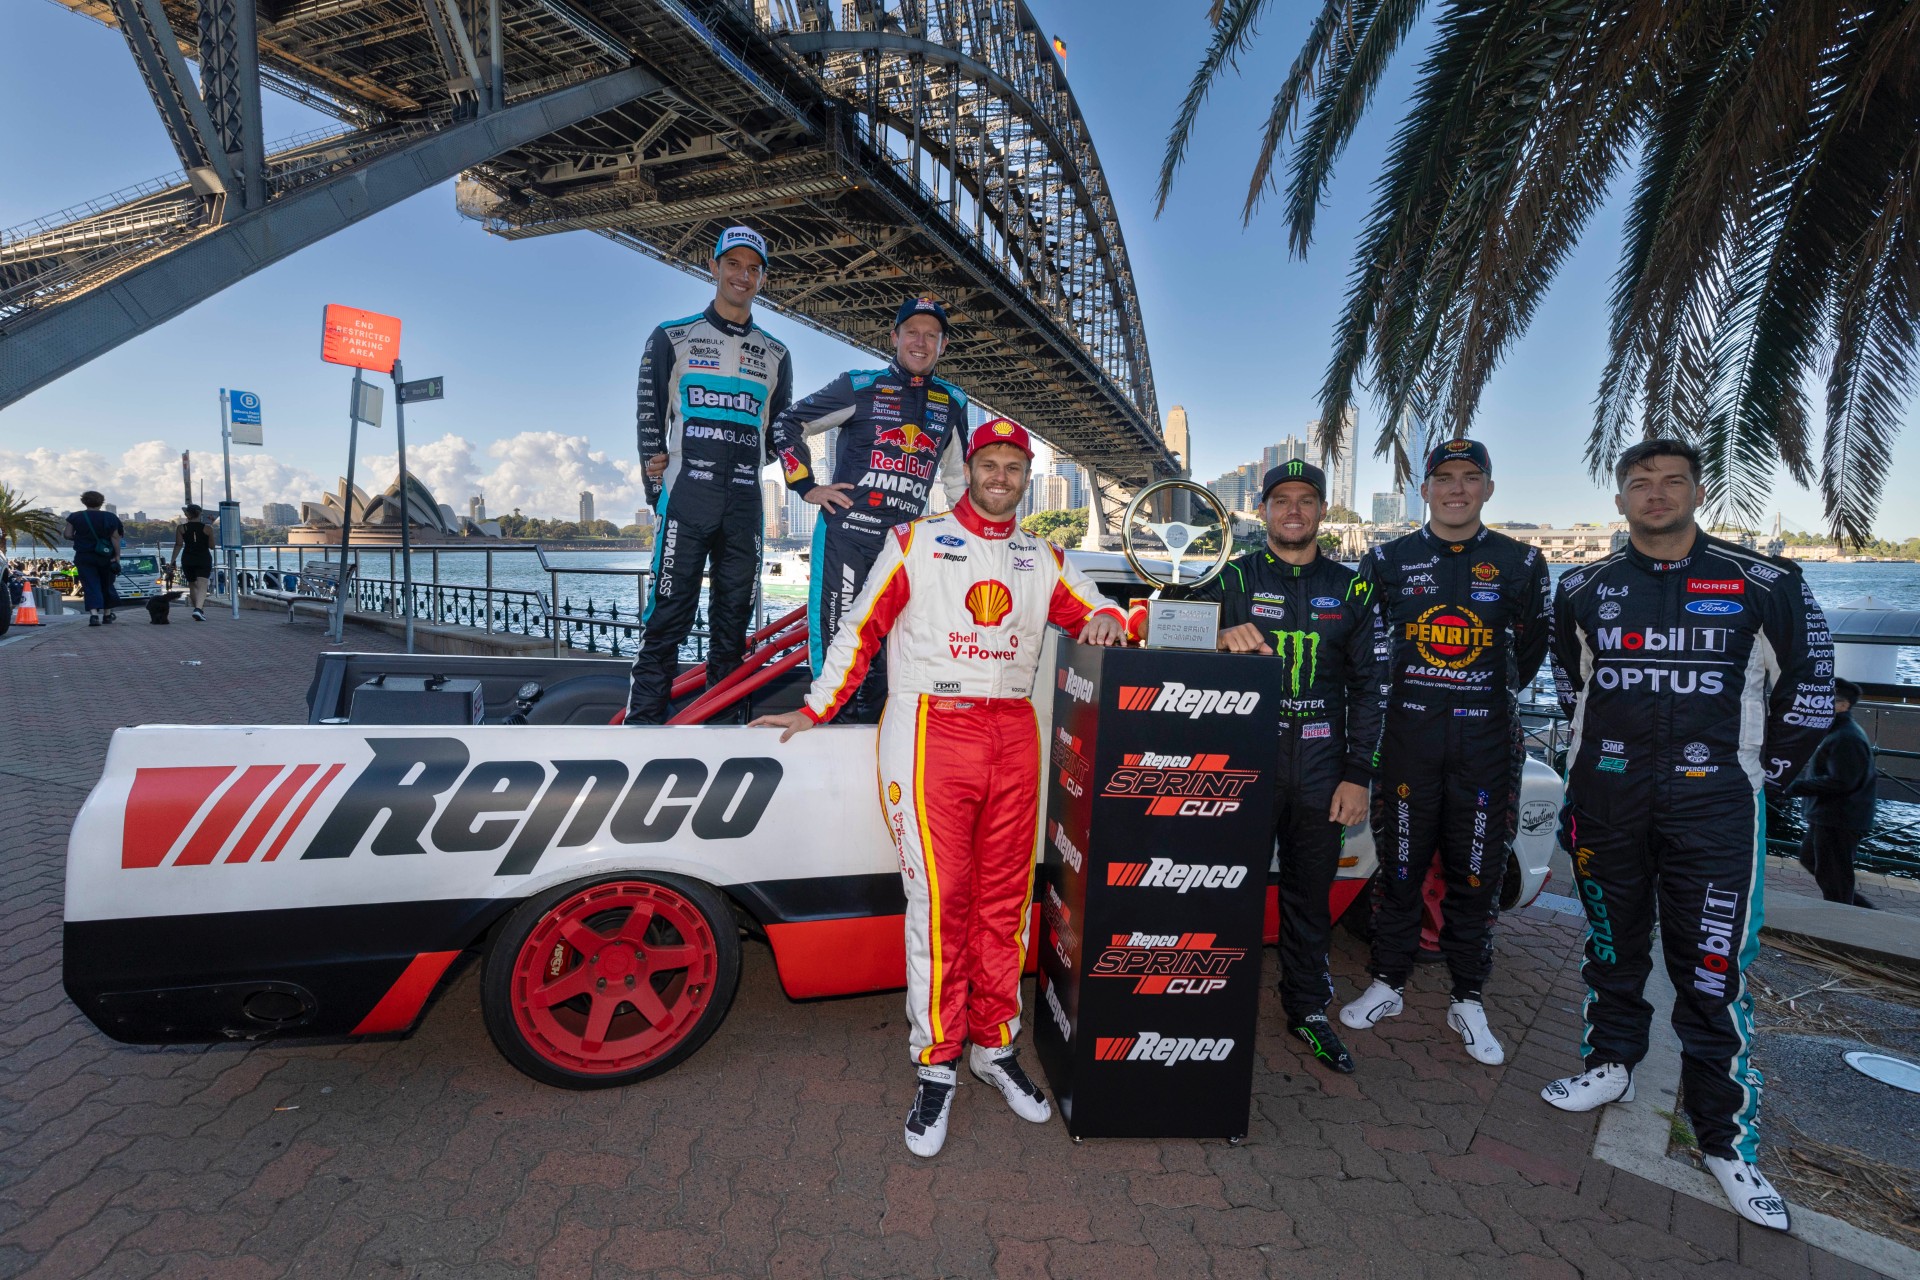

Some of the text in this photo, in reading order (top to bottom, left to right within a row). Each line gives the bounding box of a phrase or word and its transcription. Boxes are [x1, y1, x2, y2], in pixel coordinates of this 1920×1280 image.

[728, 232, 762, 246] Bendix
[355, 320, 374, 330] END
[336, 325, 391, 343] RESTRICTED
[669, 330, 685, 338] OMP
[342, 336, 383, 351] PARKING
[741, 342, 766, 355] AGI
[350, 347, 375, 359] AREA
[746, 357, 766, 368] TES
[245, 396, 254, 406] B
[687, 386, 761, 416] Bendix
[873, 406, 900, 416] Partners
[685, 425, 758, 447] SUPAGLASS
[870, 450, 934, 480] Red Bull
[857, 472, 928, 501] AMPOL
[846, 511, 881, 524] ACDelco
[940, 536, 960, 546] Ford
[660, 520, 679, 597] SUPAGLASS
[943, 552, 967, 563] Repco
[1402, 562, 1433, 571] Steadfast
[1472, 567, 1500, 576] PENRITE
[1653, 560, 1681, 571] Mobil
[1750, 565, 1778, 580] OMP
[1407, 572, 1435, 585] APEX
[1564, 573, 1584, 589] OMP
[1691, 582, 1740, 590] MORRIS
[1402, 586, 1437, 595] GROVE
[1597, 582, 1629, 600] yes
[1316, 598, 1334, 606] Ford
[1698, 602, 1729, 612] Ford
[829, 591, 838, 634] Premium
[949, 632, 977, 643] Shell
[1405, 622, 1493, 647] PENRITE
[1597, 627, 1685, 651] Mobil
[949, 645, 1017, 661] V-Power
[1405, 665, 1468, 679] RACING
[935, 682, 959, 690] rpm
[1065, 667, 1094, 704] Repco
[1404, 679, 1434, 687] AUSTRALIAN
[1597, 667, 1724, 695] OPTUS
[1797, 682, 1830, 692] Spicers
[1151, 681, 1260, 719] Repco
[1280, 699, 1325, 711] NSTER
[1793, 694, 1835, 709] NGK
[1468, 709, 1489, 717] MATT
[1806, 715, 1835, 723] TRUCK
[1800, 720, 1832, 729] ASSIST
[1303, 728, 1330, 738] RACEGEAR
[1602, 741, 1624, 752] OMP
[1051, 739, 1090, 783] SPRINT
[1139, 752, 1191, 770] Repco
[1675, 765, 1719, 773] SUPERCHEAP
[1066, 777, 1083, 799] CUP
[1105, 769, 1259, 797] SPRINT
[301, 737, 784, 876] Repco
[1179, 800, 1241, 817] CUP
[1398, 800, 1410, 862] SINCE 1926
[1054, 822, 1083, 874] Repco
[1469, 811, 1487, 875] SINCE 1926
[1576, 847, 1595, 877] yes
[1139, 857, 1248, 894] Repco
[1583, 879, 1617, 965] OPTUS
[1127, 932, 1179, 949] Repco
[1056, 941, 1072, 969] CUP
[1093, 950, 1246, 974] SPRINT
[1694, 917, 1733, 998] Mobil
[1166, 979, 1227, 994] CUP
[1045, 976, 1072, 1043] Repco
[1127, 1031, 1235, 1066] Repco
